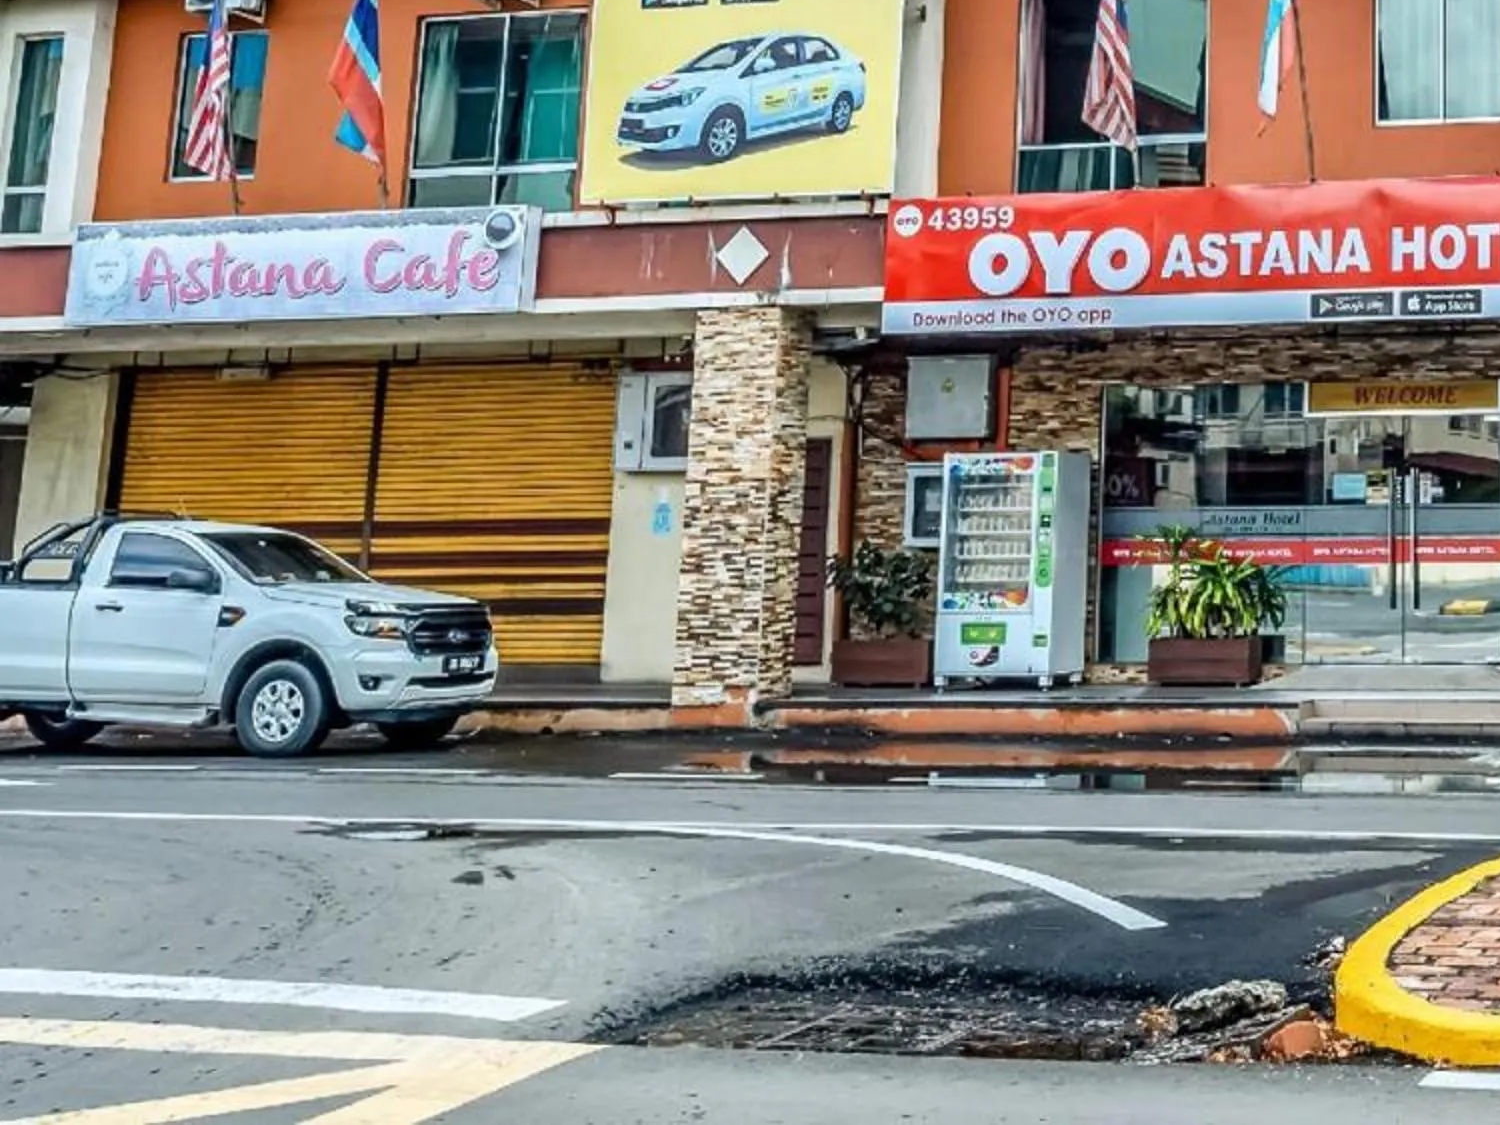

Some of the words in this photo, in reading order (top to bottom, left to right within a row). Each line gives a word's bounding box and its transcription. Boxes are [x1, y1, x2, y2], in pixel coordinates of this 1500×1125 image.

[928, 206, 1015, 232] 43959
[136, 239, 345, 313] Astana
[364, 225, 501, 298] Cafe
[968, 227, 1151, 297] OYO
[1160, 227, 1373, 280] ASTANA
[913, 308, 995, 327] Download
[1001, 309, 1027, 324] the
[1032, 307, 1072, 322] OYO
[1077, 308, 1112, 324] app
[1354, 385, 1459, 406] WELCOME
